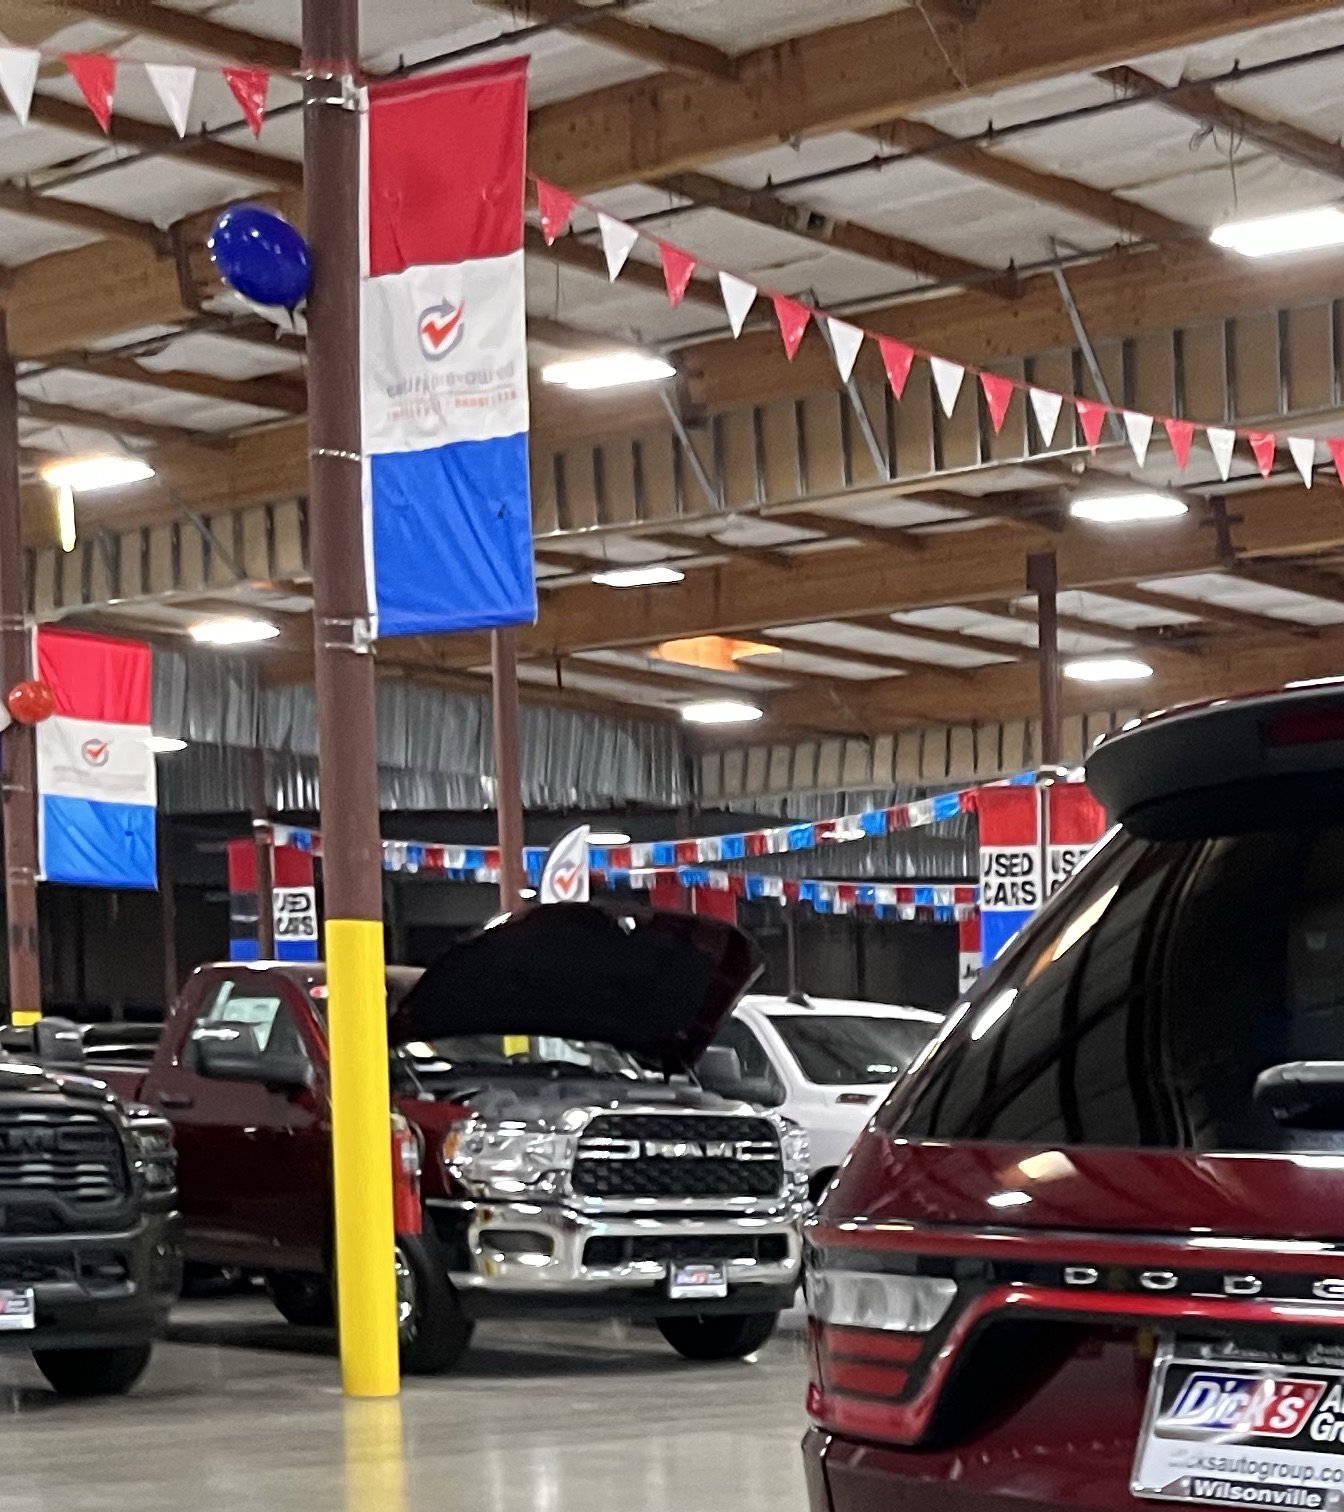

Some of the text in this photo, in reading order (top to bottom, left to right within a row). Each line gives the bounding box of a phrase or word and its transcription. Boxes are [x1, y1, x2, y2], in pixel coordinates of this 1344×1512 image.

[983, 852, 1034, 878] USED
[983, 880, 1037, 906] CARS
[644, 1141, 735, 1158] RAM
[1193, 1478, 1323, 1509] Wilsonville
